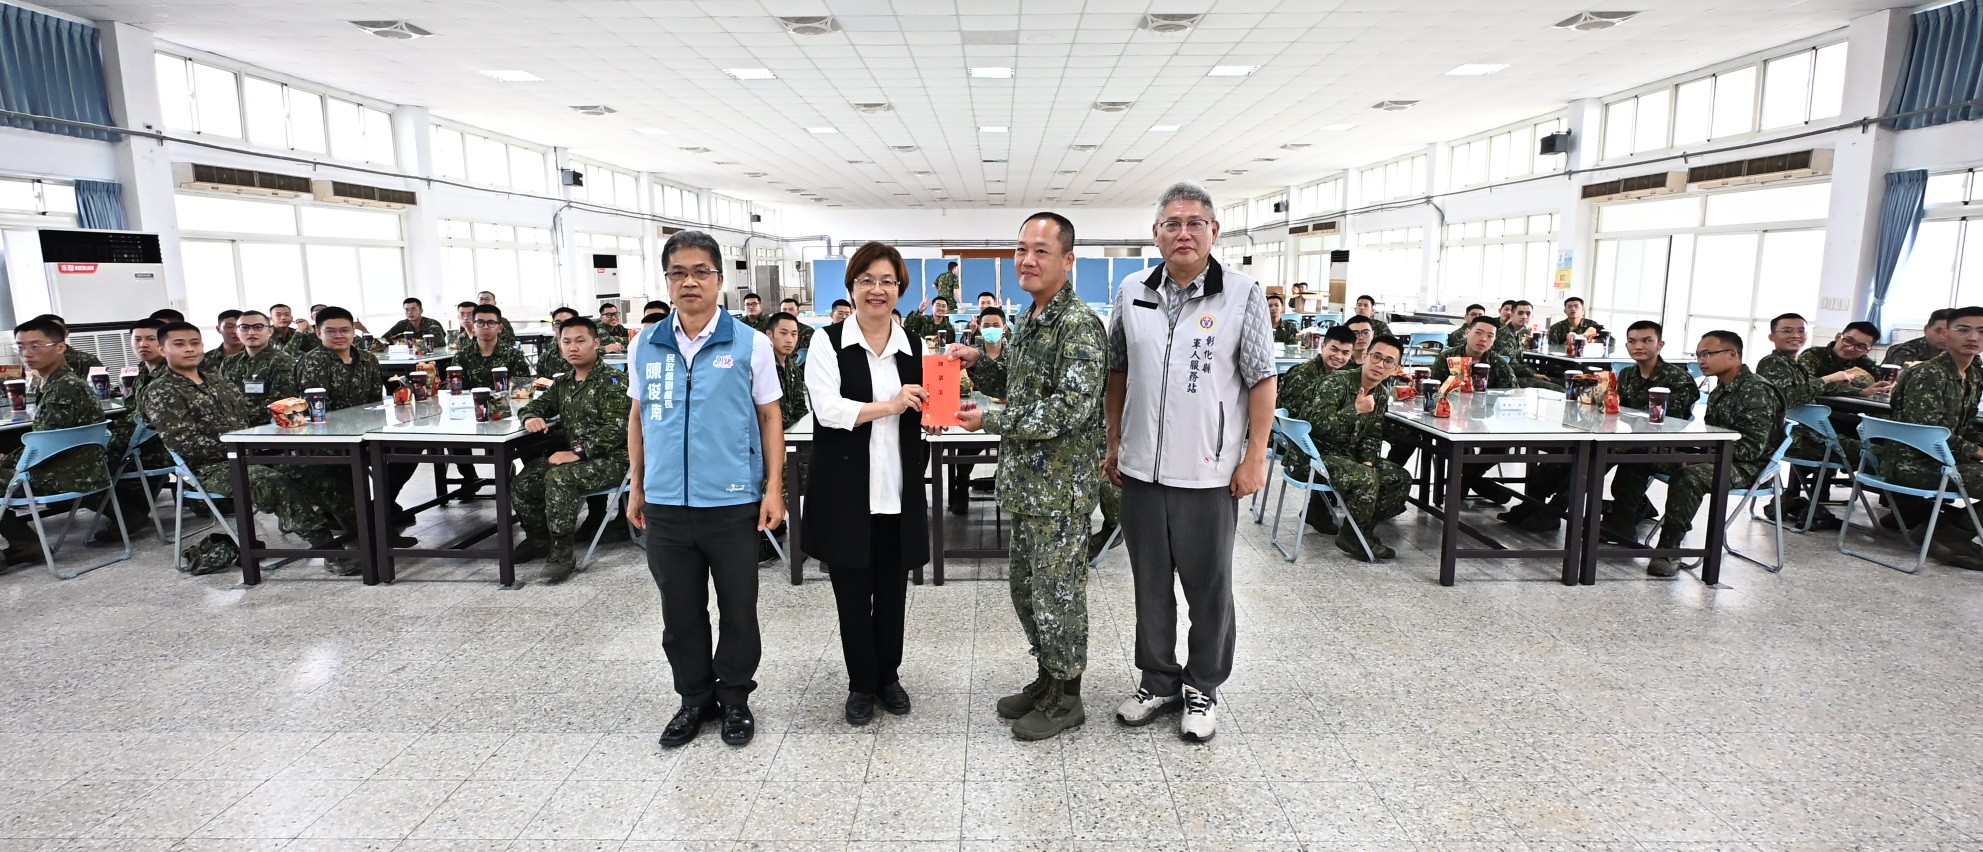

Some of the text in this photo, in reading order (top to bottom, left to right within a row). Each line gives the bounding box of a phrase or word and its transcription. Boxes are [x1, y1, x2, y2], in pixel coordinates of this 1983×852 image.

[1186, 338, 1202, 394] 軍人服務站
[1201, 335, 1216, 374] 彰化縣
